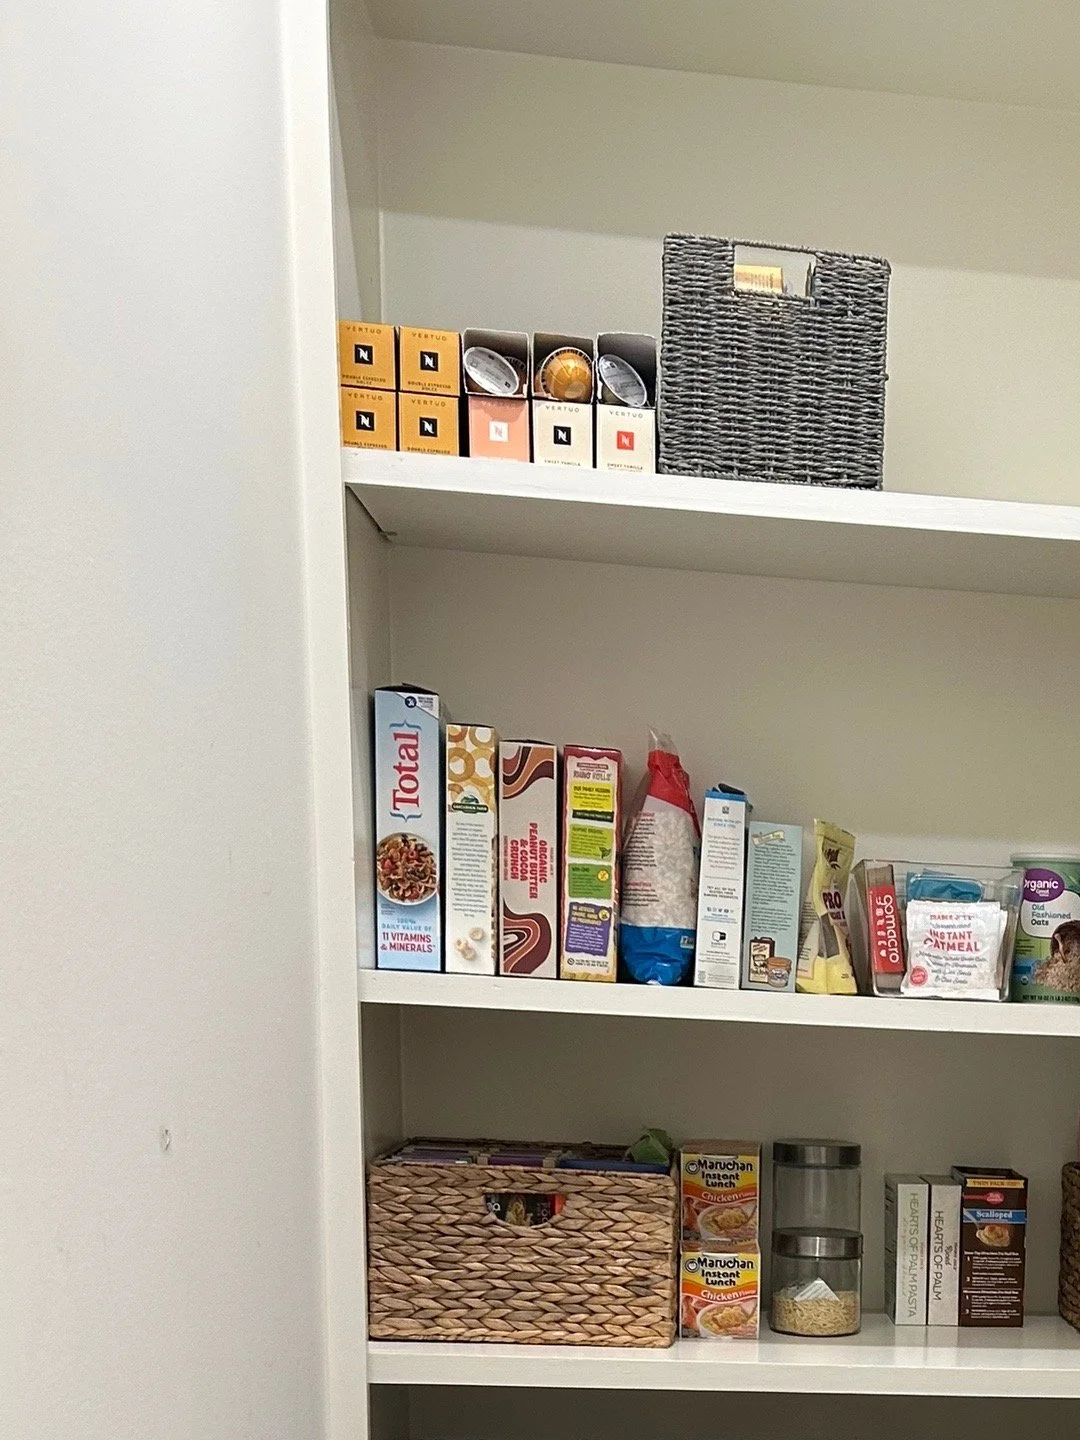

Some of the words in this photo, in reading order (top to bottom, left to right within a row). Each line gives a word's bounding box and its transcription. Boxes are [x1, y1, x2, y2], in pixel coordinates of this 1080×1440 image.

[346, 326, 382, 335] VERTUO
[412, 333, 447, 341] VERTUO
[347, 392, 383, 401] VERTUO
[411, 399, 446, 407] VERTUO
[545, 405, 580, 413] VERTUO
[609, 410, 643, 419] VERTUO
[393, 731, 419, 811] Total
[529, 822, 538, 860] PEANUT
[510, 839, 519, 880] CRUNCH
[539, 840, 547, 883] ORGANIC
[520, 850, 528, 881] COCOA
[529, 862, 538, 899] BUTTER
[1032, 911, 1072, 920] Fashioned
[383, 932, 389, 940] 11
[391, 932, 431, 943] VITAMINS
[929, 928, 972, 940] INSTANT
[389, 942, 433, 953] MINERALS
[698, 1159, 753, 1171] Maruchan
[702, 1171, 740, 1181] Instant
[706, 1180, 735, 1188] Lunch
[701, 1191, 738, 1202] Chicken
[908, 1193, 919, 1238] HEARTS
[977, 1211, 1013, 1219] Scalloped
[934, 1211, 944, 1253] HEARTS
[908, 1238, 918, 1253] OF
[697, 1257, 754, 1269] Maruchan
[934, 1254, 943, 1271] OF
[702, 1270, 740, 1278] Instant
[908, 1255, 918, 1283] PALM
[706, 1278, 736, 1286] Lunch
[932, 1271, 942, 1300] PALM
[701, 1290, 739, 1301] Chicken
[907, 1284, 917, 1317] PASTA
